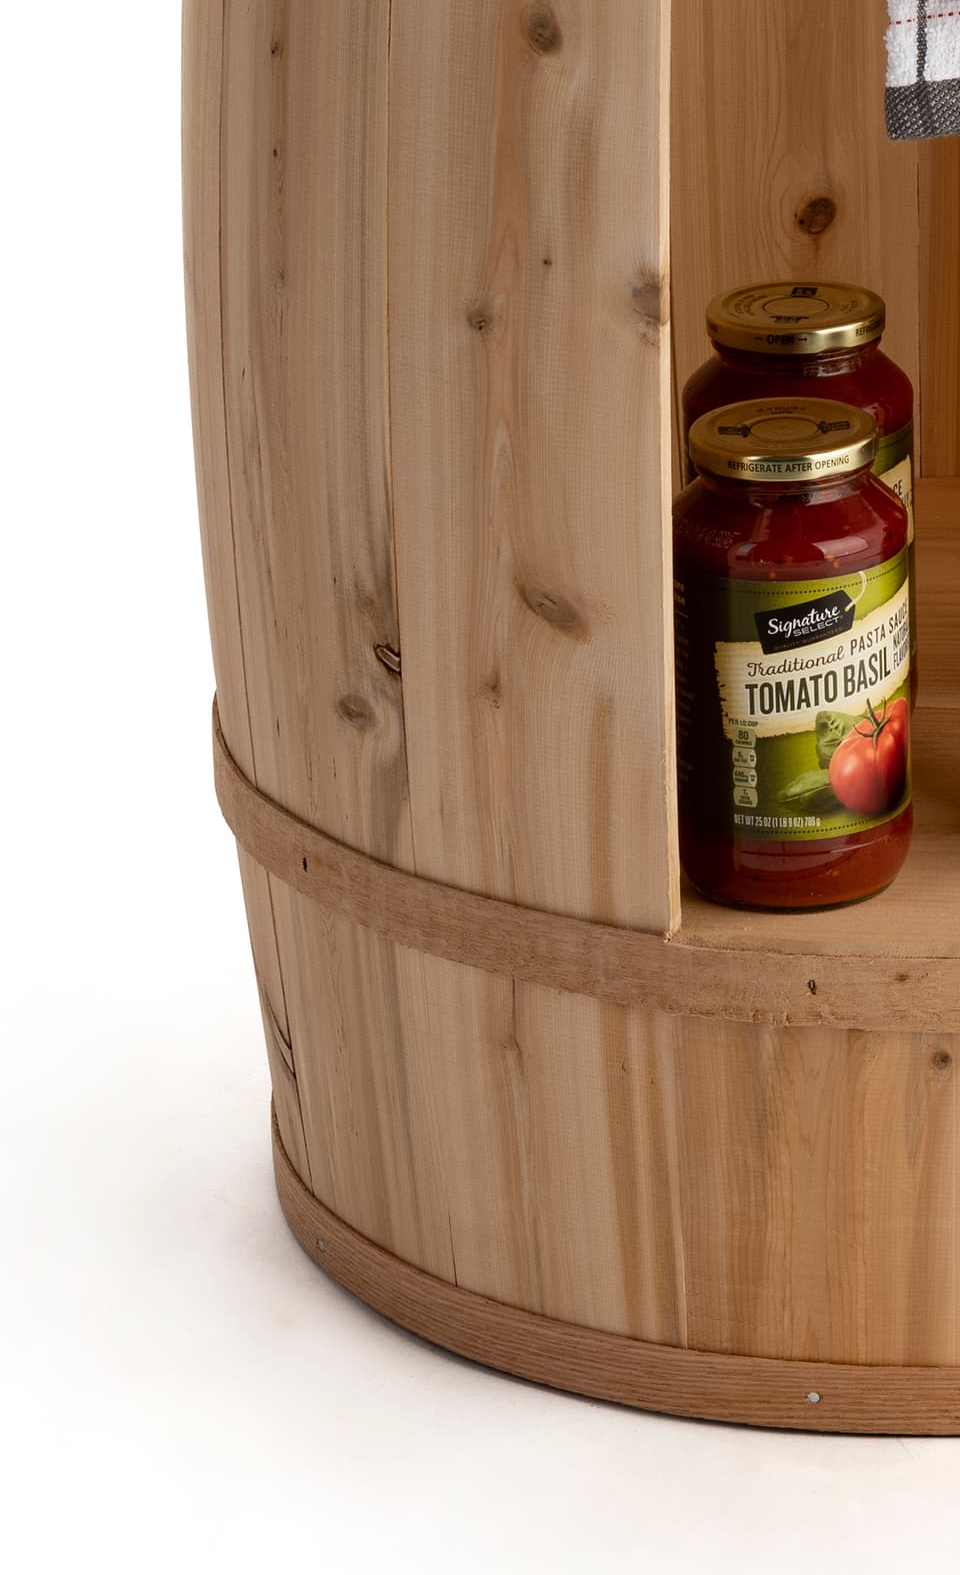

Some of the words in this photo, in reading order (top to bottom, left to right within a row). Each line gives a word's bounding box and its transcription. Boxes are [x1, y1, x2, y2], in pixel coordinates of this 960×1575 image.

[727, 459, 783, 474] REFRIGERATE
[784, 461, 813, 473] AFTER
[814, 454, 850, 470] OPENING
[767, 603, 841, 639] Signature
[792, 617, 840, 638] SELECT
[747, 644, 846, 677] Traditional
[849, 626, 887, 656] PASTA
[745, 668, 839, 716] TOMATO
[843, 646, 891, 698] BASIL
[738, 729, 749, 740] 80
[744, 814, 755, 826] WT
[755, 815, 763, 827] 25
[763, 816, 772, 827] OZ
[779, 817, 788, 828] LB
